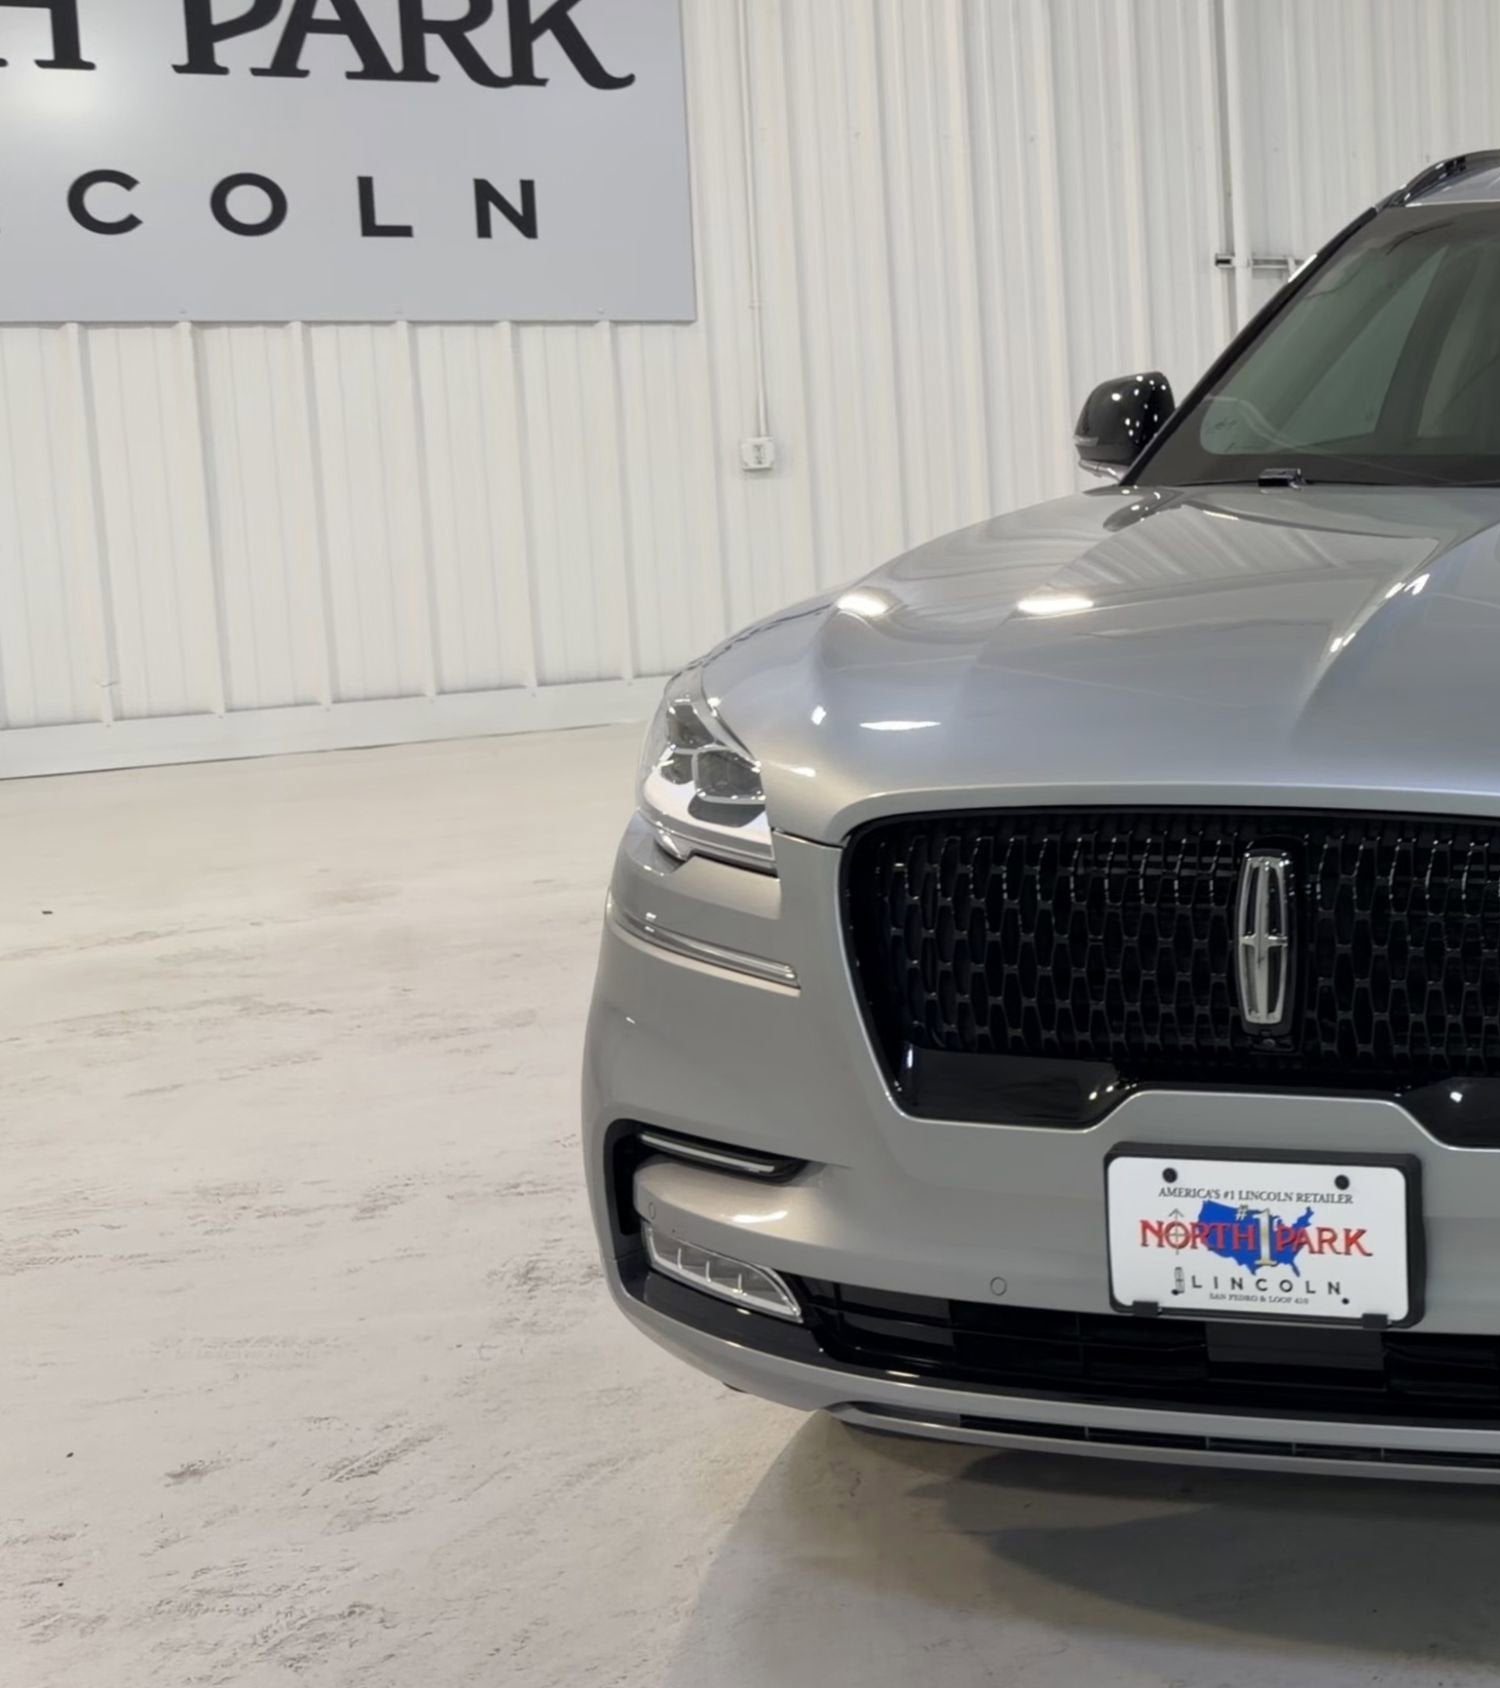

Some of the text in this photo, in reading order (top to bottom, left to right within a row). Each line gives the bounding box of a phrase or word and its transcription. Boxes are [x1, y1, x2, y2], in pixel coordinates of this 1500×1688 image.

[172, 0, 636, 90] PARK
[1158, 1187, 1353, 1205] AMERICA'S #1 LINCOLN RETAILER
[1139, 1219, 1373, 1257] NORTH PARK
[1191, 1275, 1340, 1295] LINCOLN
